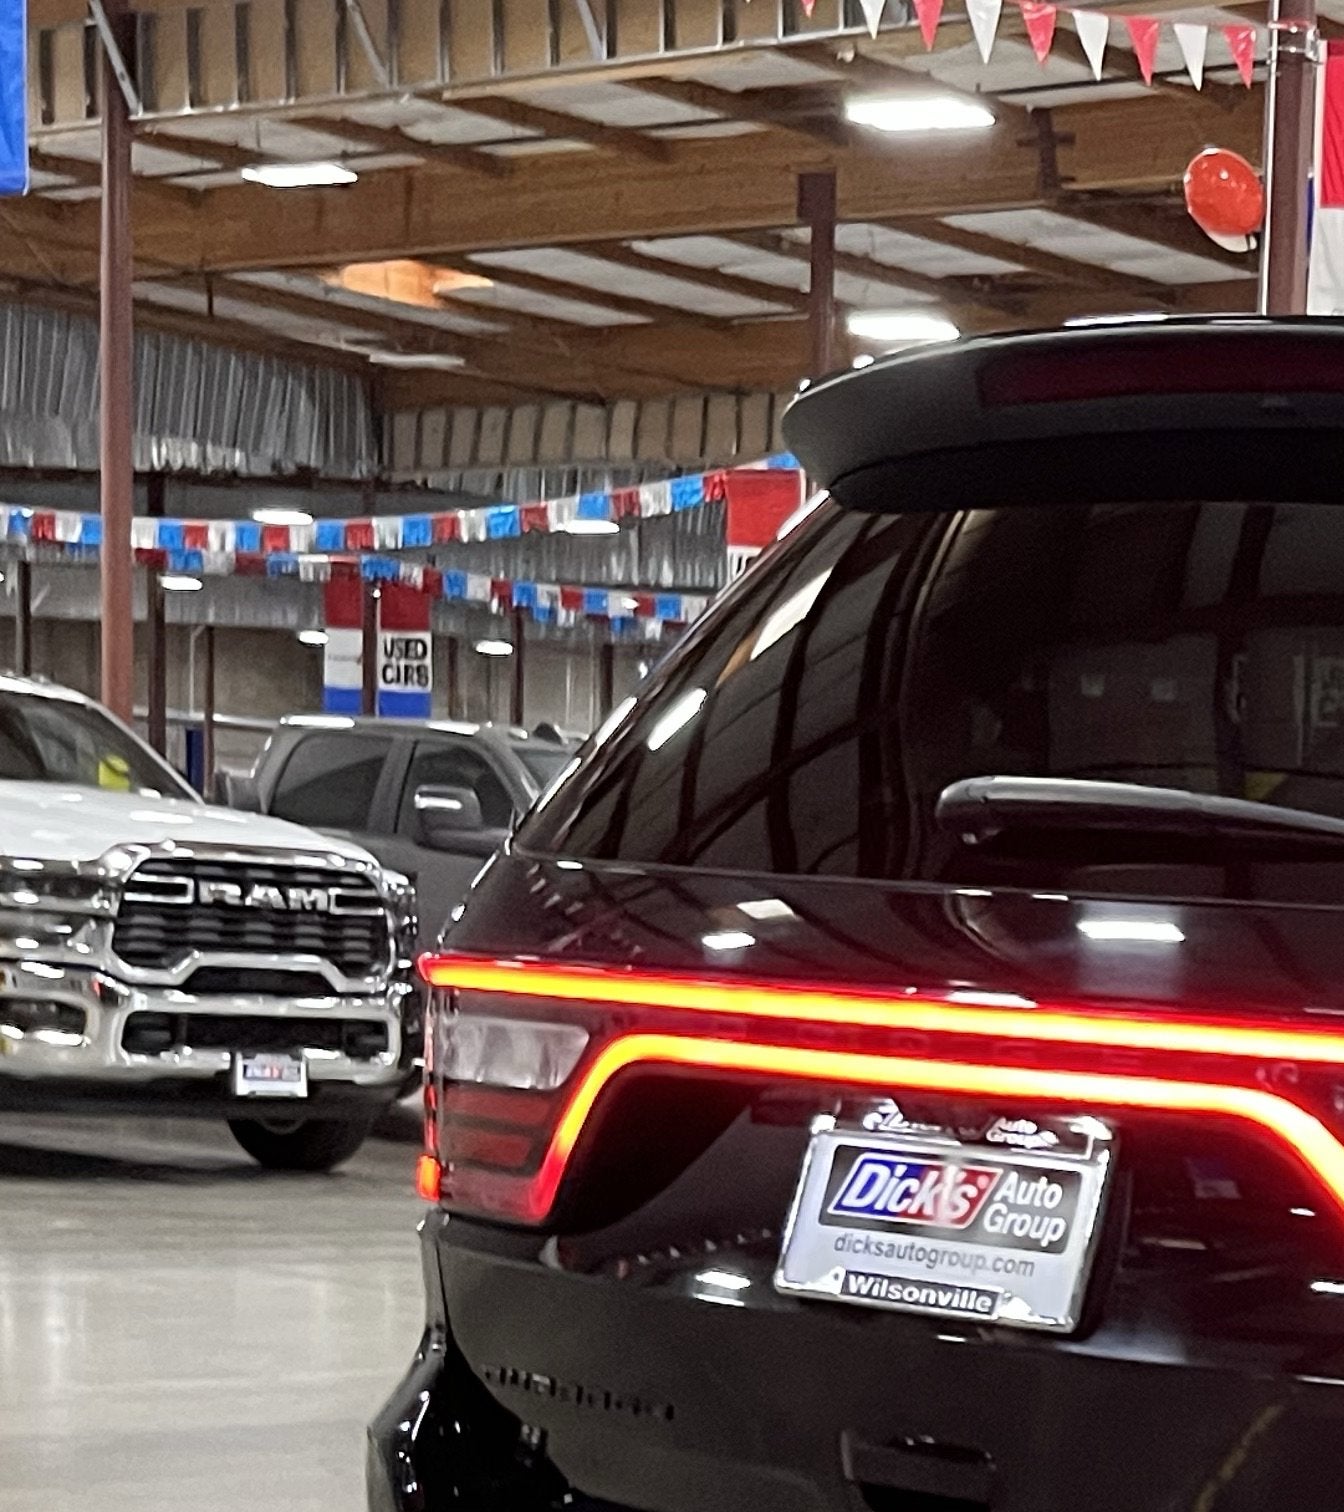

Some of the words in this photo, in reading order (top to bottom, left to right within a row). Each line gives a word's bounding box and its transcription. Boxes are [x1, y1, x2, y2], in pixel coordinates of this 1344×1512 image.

[383, 637, 428, 660] USED
[200, 879, 329, 911] RAM
[841, 1163, 978, 1220] Dick's
[993, 1171, 1063, 1210] Auto
[983, 1204, 1067, 1247] Group
[833, 1232, 1036, 1278] dicksautogroup.com
[847, 1272, 993, 1313] Wilsonville
